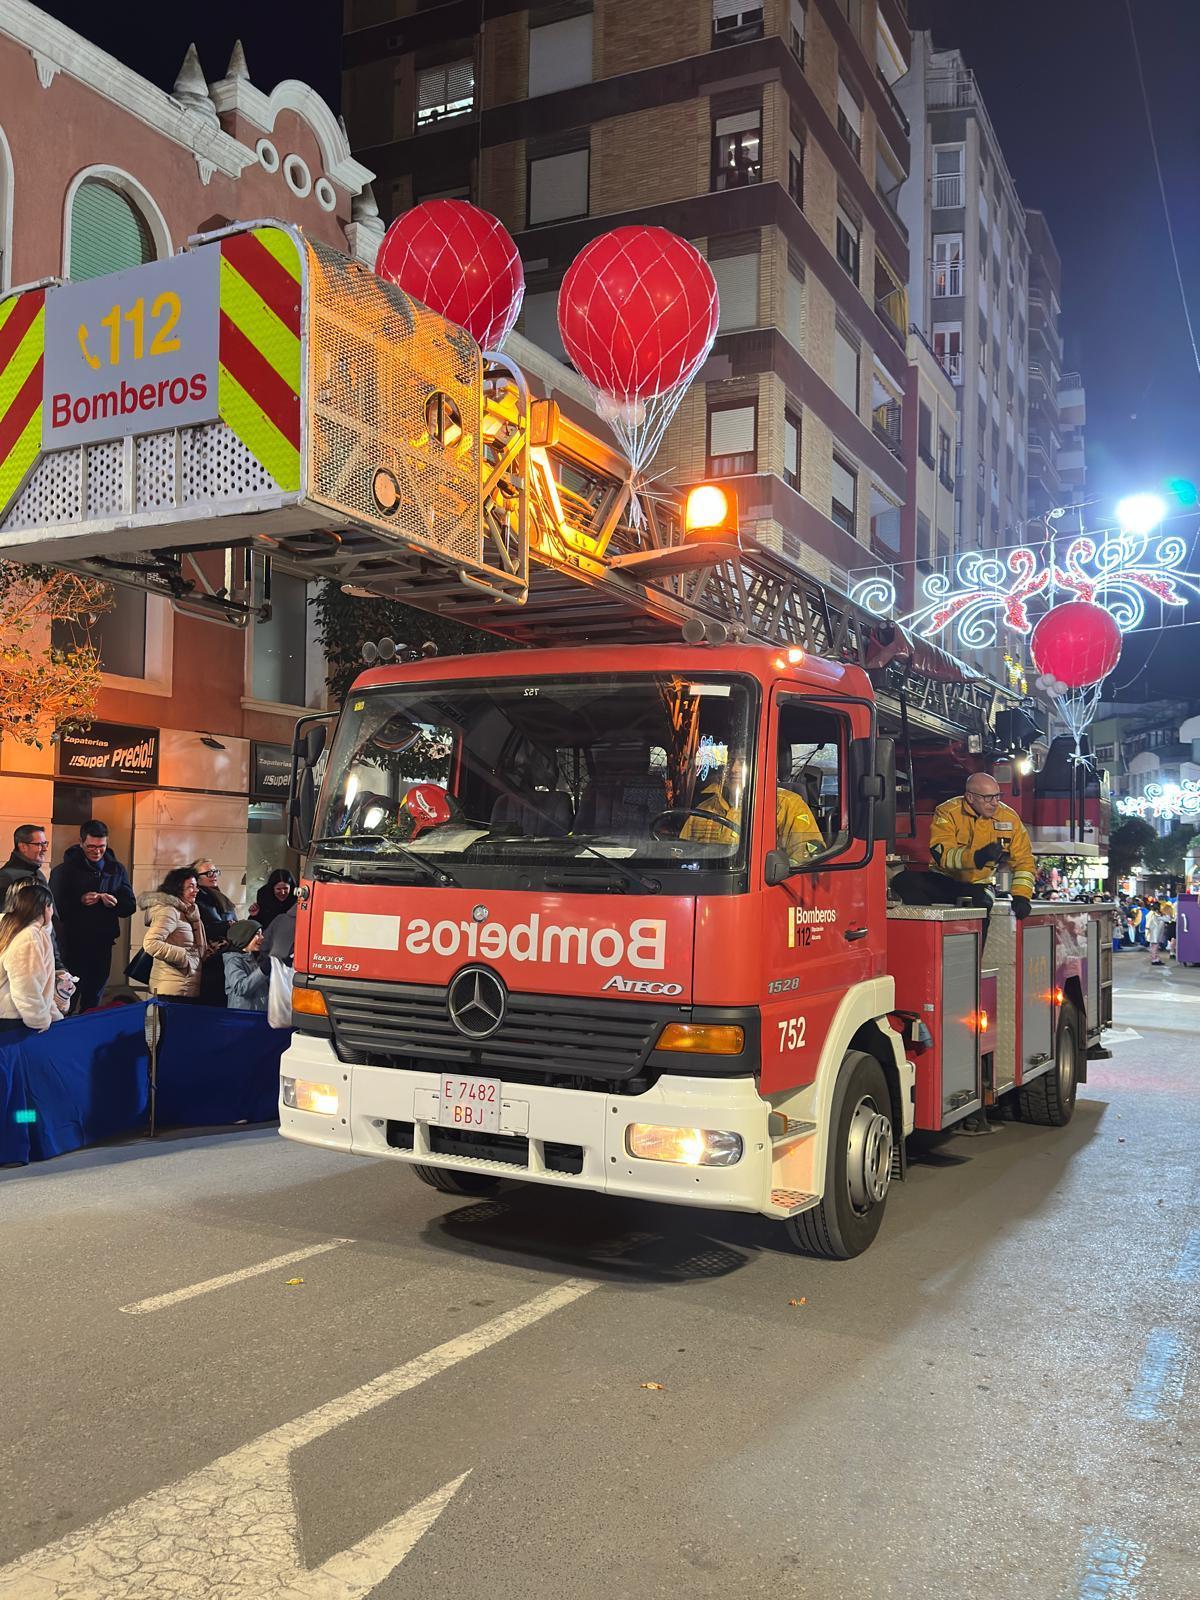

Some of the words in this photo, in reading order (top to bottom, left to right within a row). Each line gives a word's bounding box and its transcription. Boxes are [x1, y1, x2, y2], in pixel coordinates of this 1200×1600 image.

[101, 291, 181, 365] 112
[52, 373, 207, 428] Bomberos
[796, 906, 836, 924] Bomberos
[797, 927, 811, 947] 112
[768, 977, 800, 994] 1528
[778, 1016, 806, 1053] 752
[445, 1081, 453, 1098] E
[460, 1083, 496, 1102] 7482
[454, 1105, 484, 1125] BBJ
